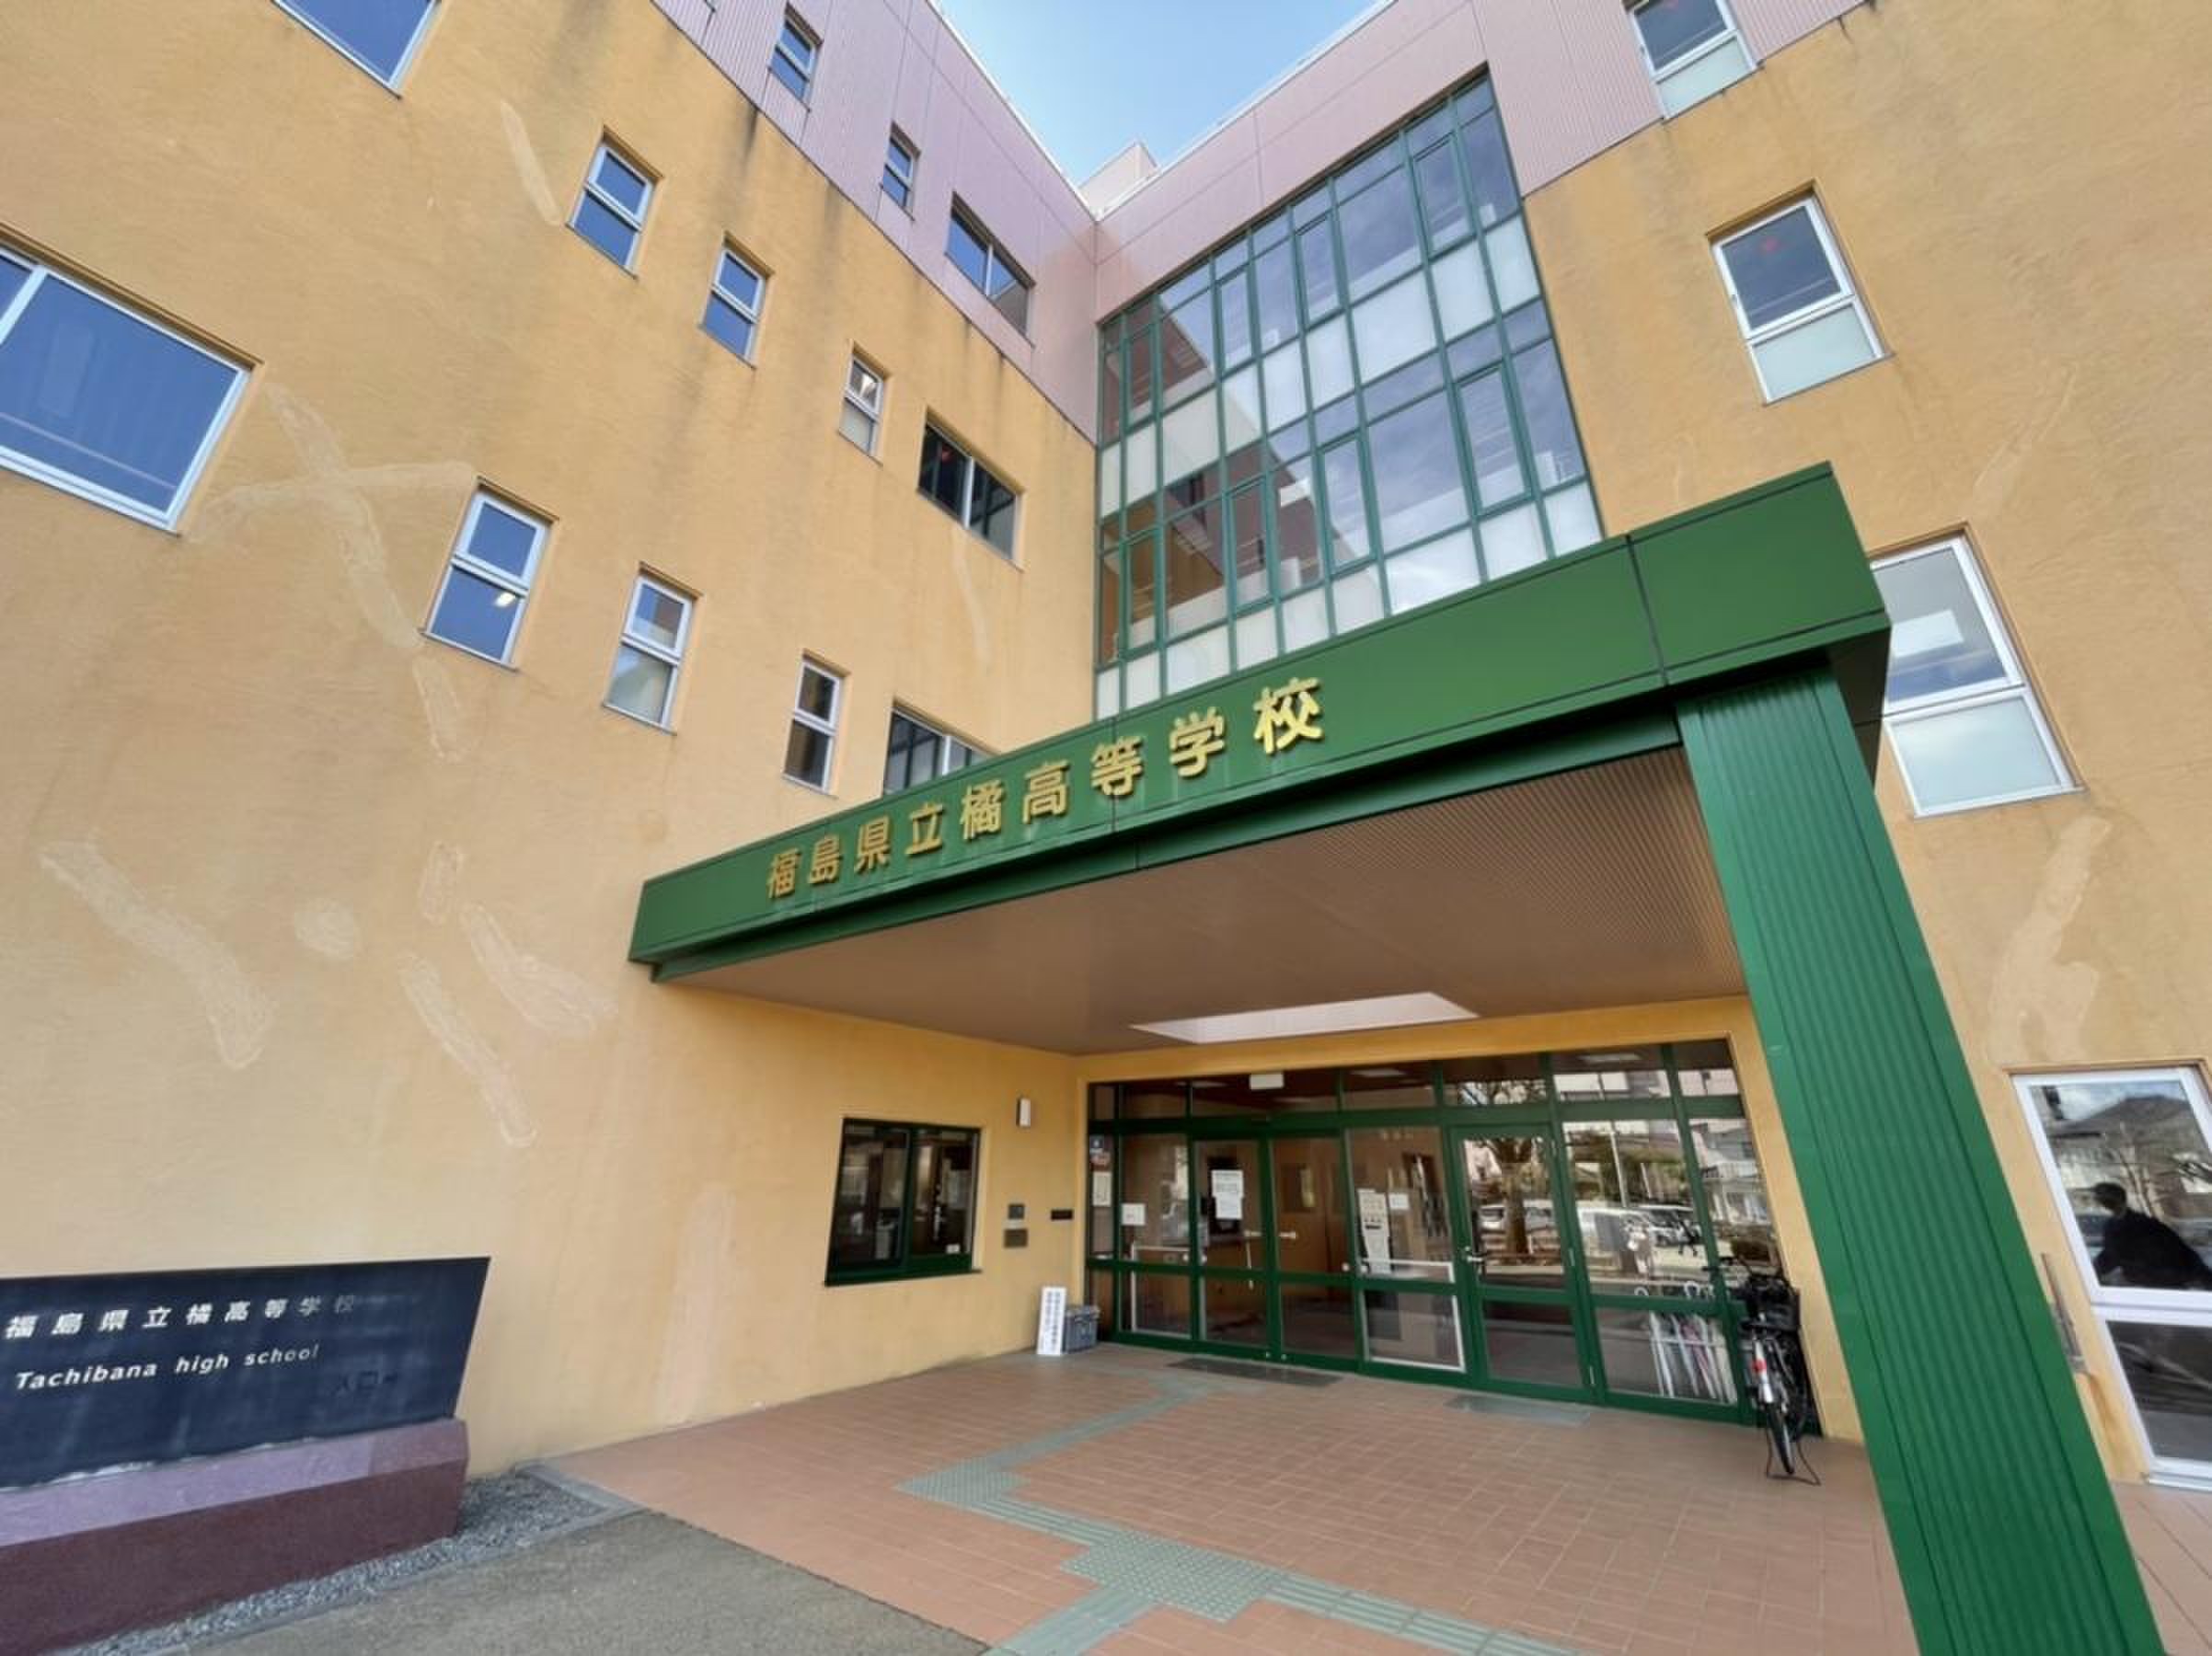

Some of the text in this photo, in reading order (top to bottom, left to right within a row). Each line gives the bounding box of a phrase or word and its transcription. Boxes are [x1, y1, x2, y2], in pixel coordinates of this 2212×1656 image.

[766, 677, 1322, 899] 福島県立橘高等学校
[5, 1294, 354, 1339] 福島県立橘高等学校
[16, 1344, 319, 1389] Tachibana high school
